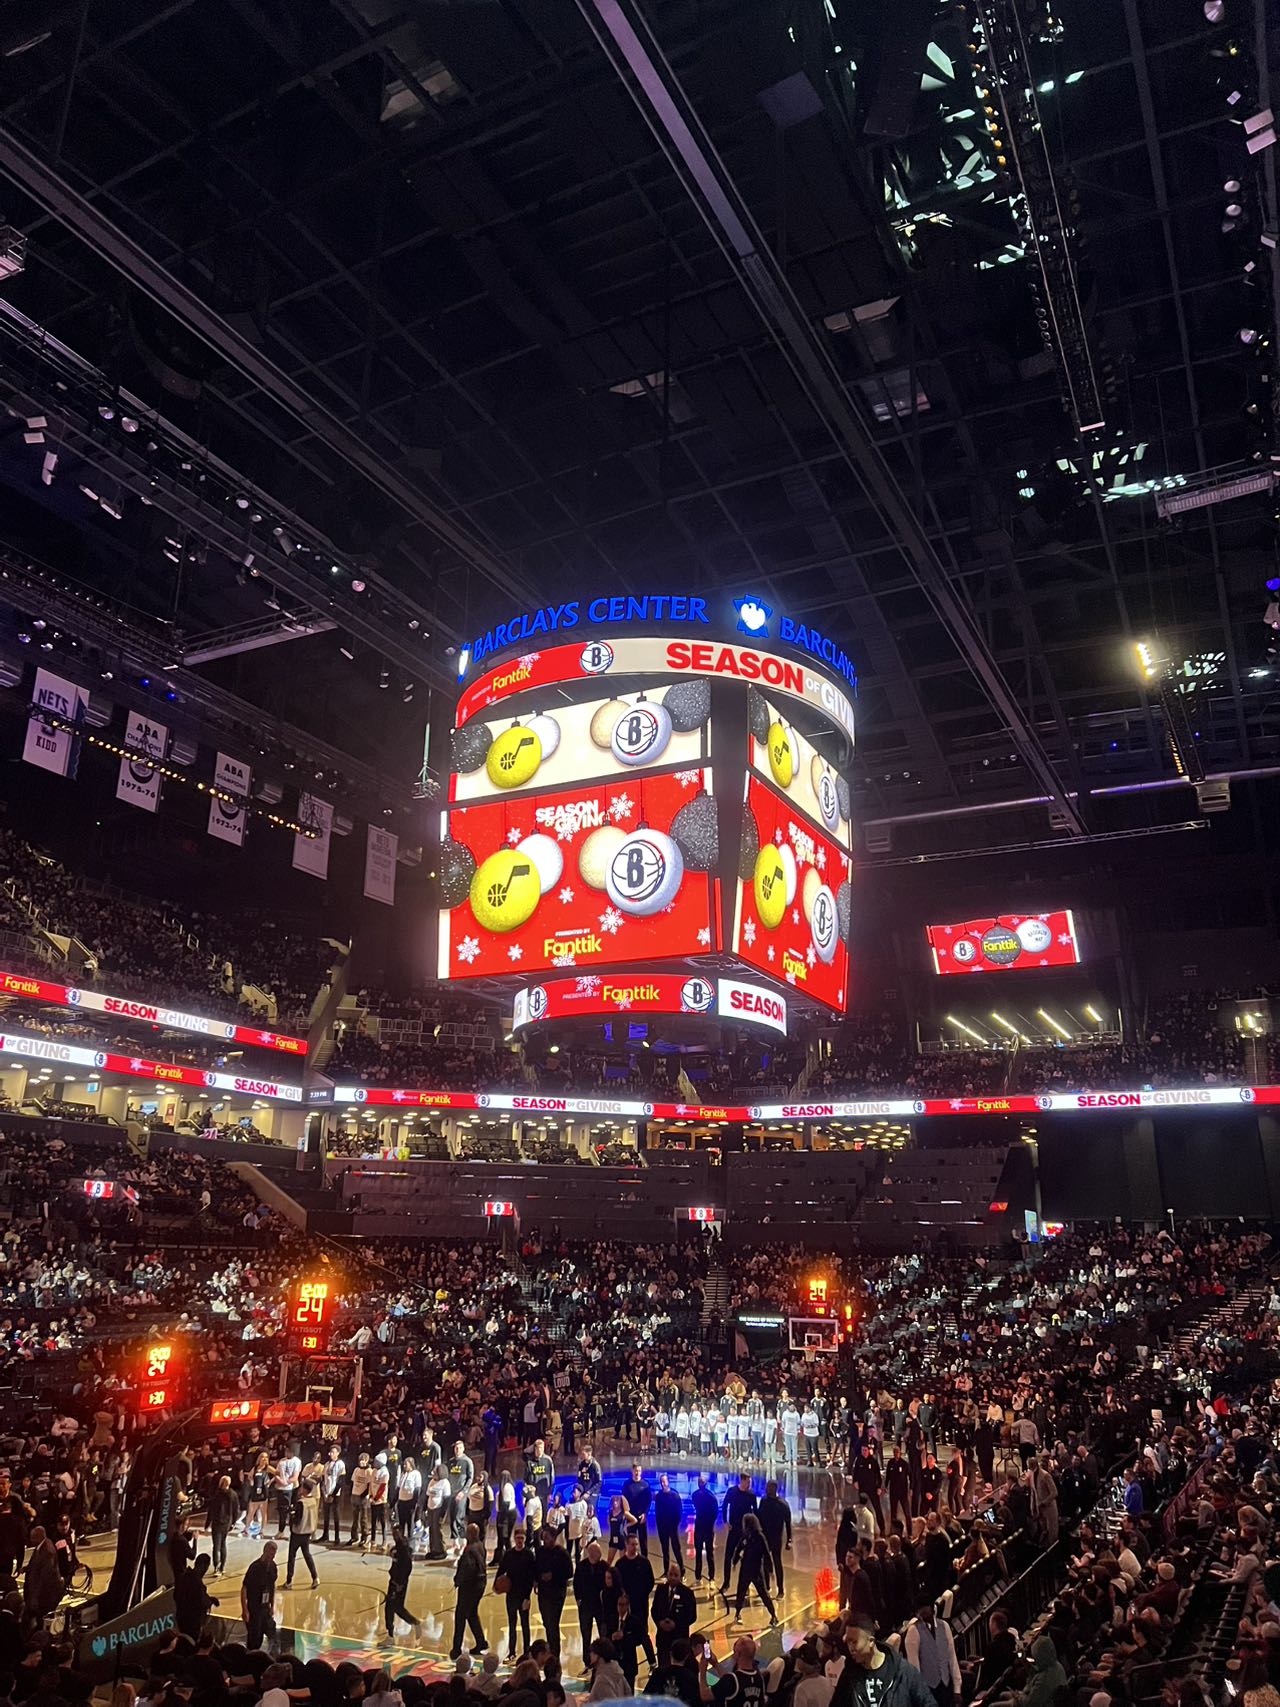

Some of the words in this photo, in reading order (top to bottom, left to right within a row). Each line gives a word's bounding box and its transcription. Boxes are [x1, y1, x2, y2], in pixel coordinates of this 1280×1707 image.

[472, 601, 579, 664] BARCLAYS
[588, 595, 710, 624] CENTER
[591, 646, 603, 667] B
[780, 616, 856, 688] BARCLAYS
[666, 643, 805, 695] SEASON
[805, 677, 820, 694] OF
[492, 667, 532, 692] Fanttik
[38, 688, 69, 715] NETS
[136, 722, 159, 740] ABA
[627, 716, 642, 746] B
[36, 735, 57, 753] KIDD
[224, 763, 244, 779] ABA
[536, 799, 599, 823] SEASON
[626, 848, 644, 888] B
[543, 934, 602, 958] Fanttik
[983, 939, 1017, 952] Fanttik
[783, 951, 807, 981] Fanttik
[4, 976, 41, 994] Fanttik
[603, 984, 660, 1004] Fanttik
[693, 981, 703, 1003] B
[104, 997, 157, 1020] SEASON
[166, 1010, 209, 1032] GIVING
[730, 990, 785, 1023] SEASON
[16, 1039, 70, 1060] GIVING
[275, 1037, 299, 1051] Fanttik
[154, 1065, 183, 1080] Fanttik
[234, 1078, 279, 1096] SEASON
[419, 1093, 451, 1105] Fanttik
[512, 1097, 566, 1110] SEASON
[576, 1100, 621, 1112] GIVING
[977, 1100, 1010, 1111] Fanttik
[1077, 1094, 1141, 1107] SEASON
[1153, 1091, 1211, 1104] GIVING
[699, 1107, 727, 1119] Fanttik
[782, 1105, 833, 1116] SEASON
[843, 1103, 890, 1114] GIVING
[809, 1288, 826, 1301] 24
[297, 1298, 323, 1322] 24
[303, 1337, 317, 1348] 1:30
[148, 1360, 166, 1376] 24
[149, 1391, 165, 1404] 1:30
[160, 1476, 174, 1530] BARCLAYS
[109, 1613, 174, 1650] BARCLAYS
